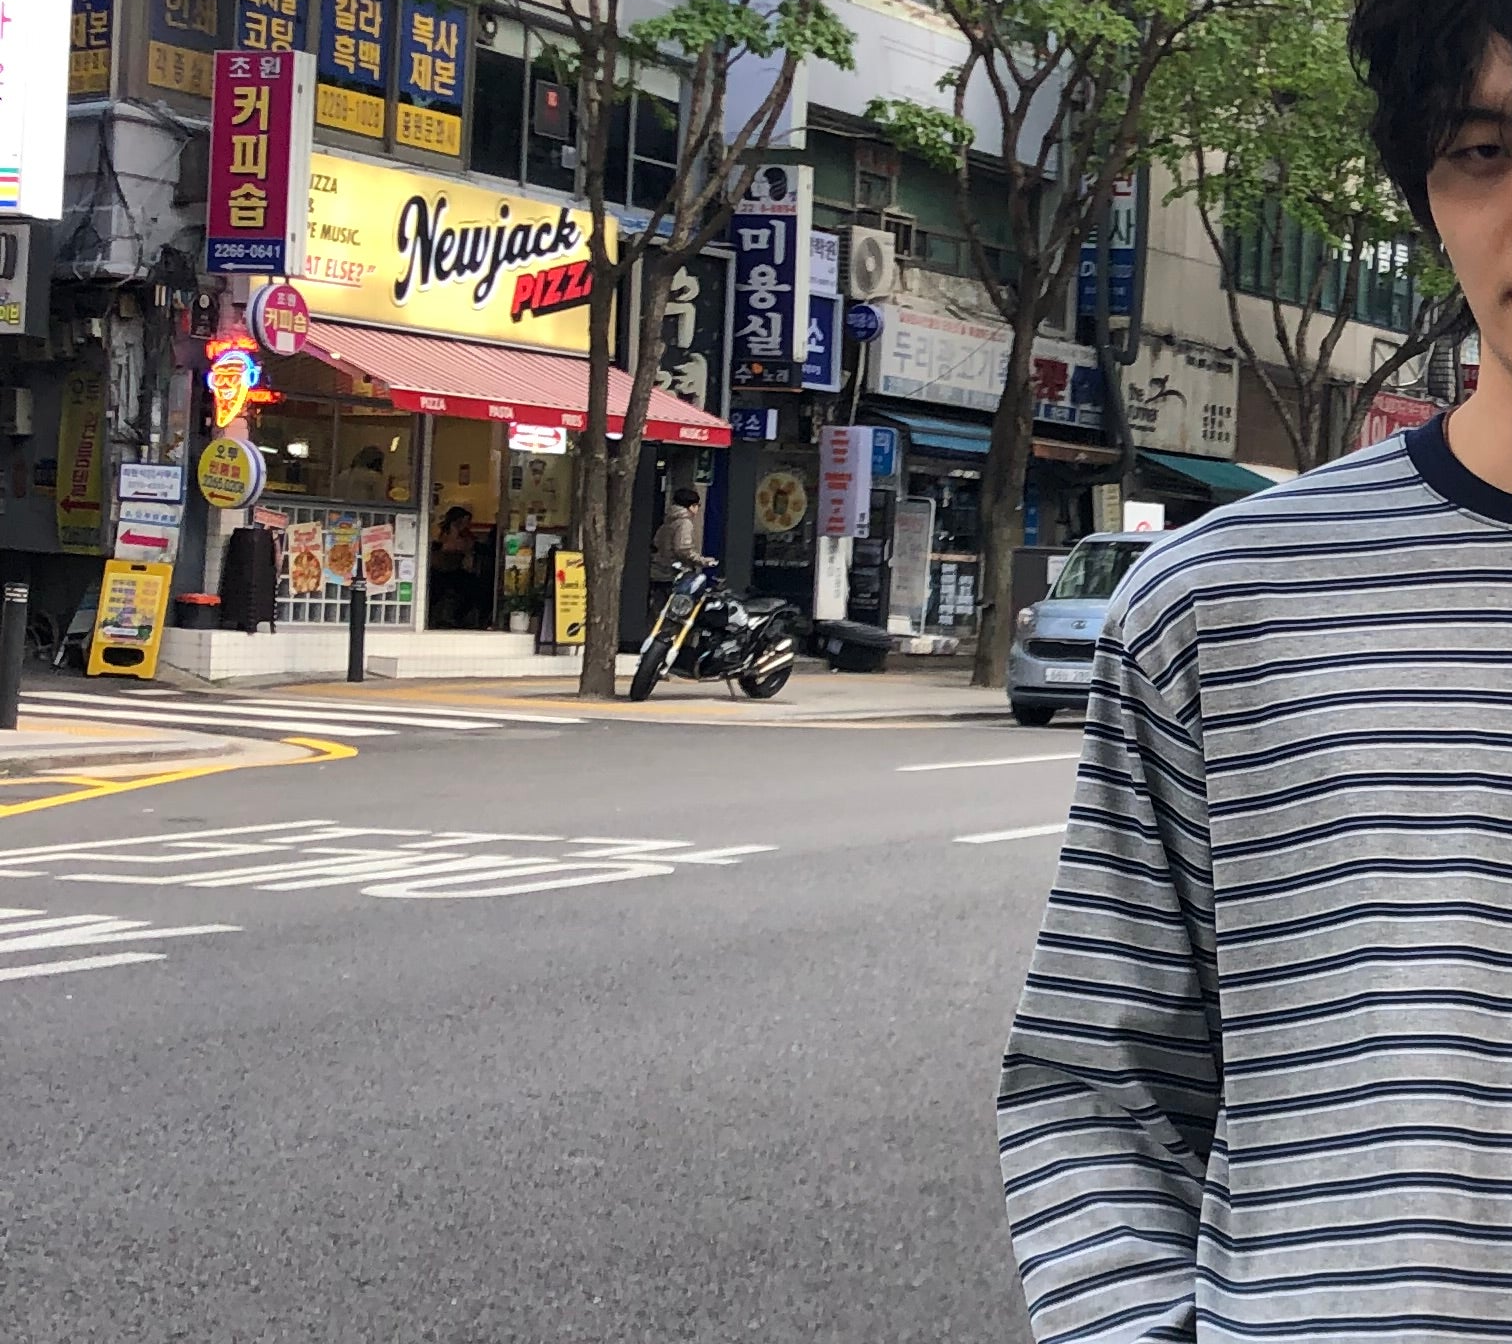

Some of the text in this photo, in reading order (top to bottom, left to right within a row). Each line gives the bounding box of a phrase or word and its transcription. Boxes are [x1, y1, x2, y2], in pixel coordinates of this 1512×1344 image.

[333, 35, 382, 81] 흑백
[411, 12, 459, 59] 복사
[229, 56, 281, 80] 초원
[409, 52, 458, 97] 제본
[229, 87, 272, 229] 커피숍
[308, 173, 338, 194] IZZA
[214, 242, 282, 261] 2266-0641
[393, 193, 581, 304] Newjack
[736, 218, 792, 358] 미용실
[264, 307, 308, 333] 커피숍
